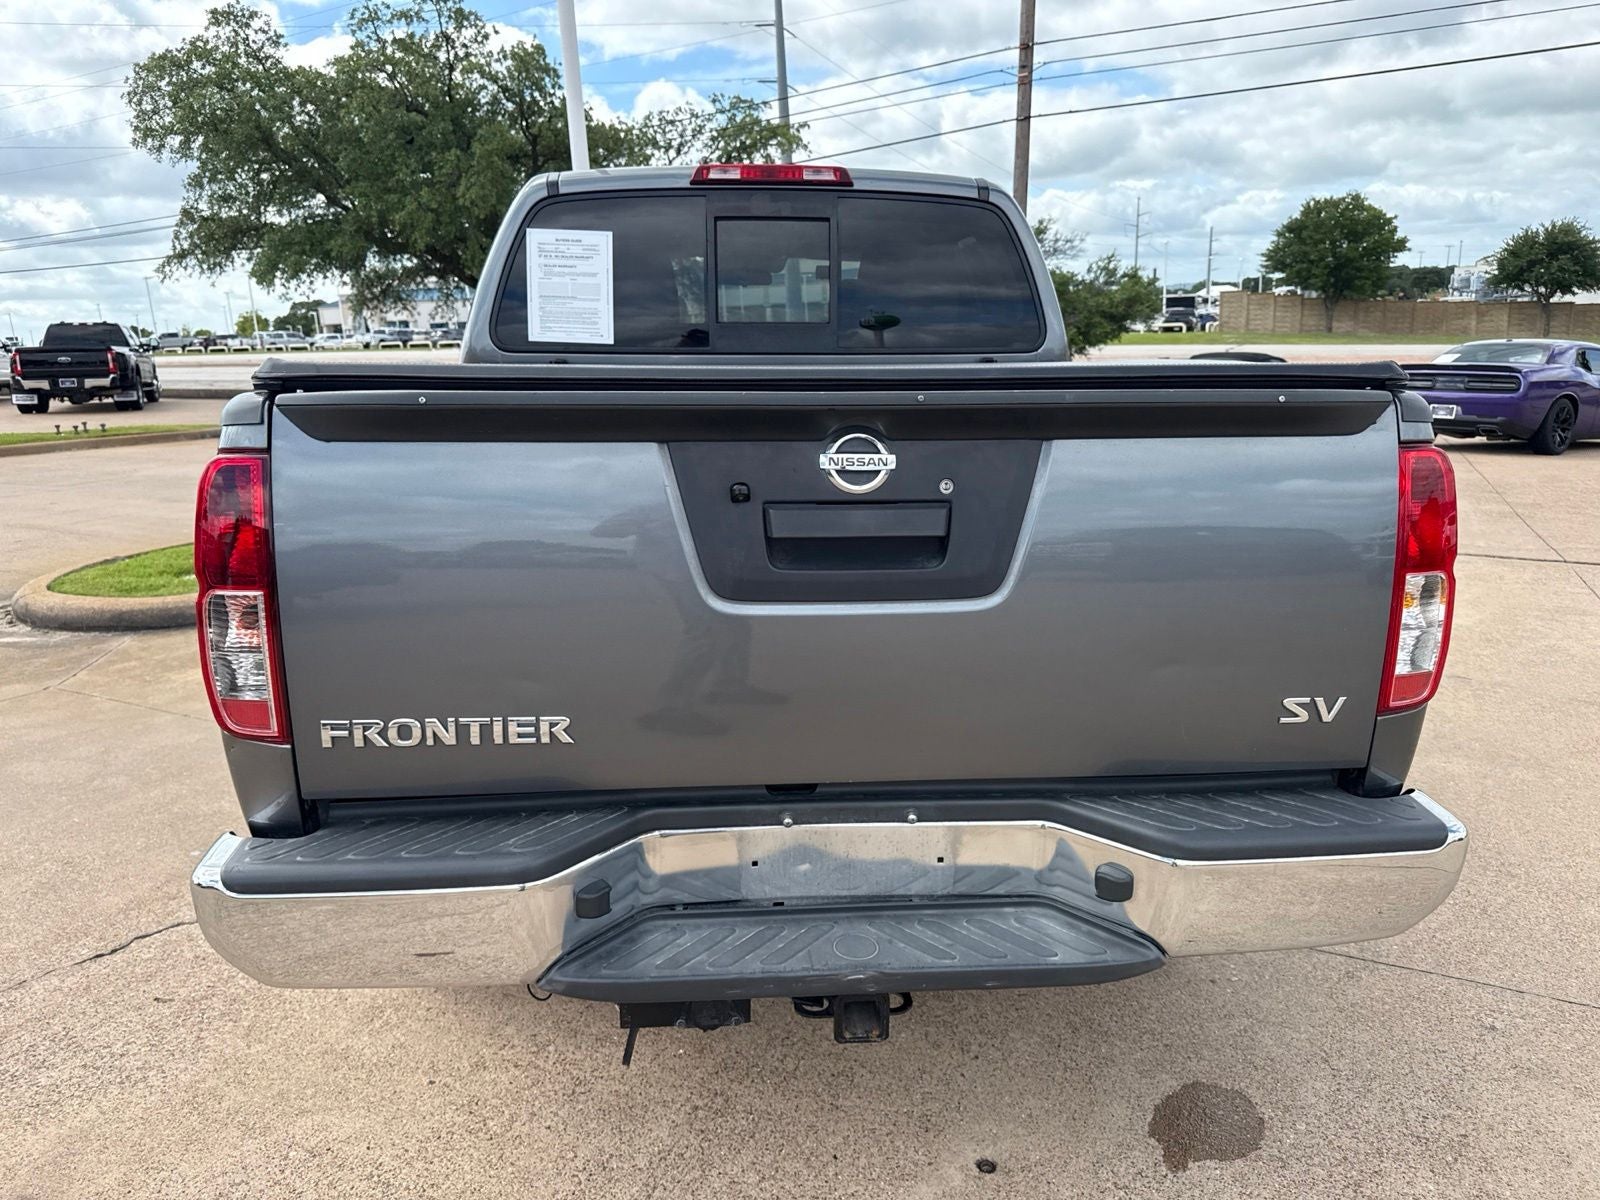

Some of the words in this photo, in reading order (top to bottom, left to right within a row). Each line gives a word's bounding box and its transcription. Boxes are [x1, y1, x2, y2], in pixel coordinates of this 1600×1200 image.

[828, 457, 888, 467] NISSAN
[1279, 696, 1347, 723] SV
[320, 716, 575, 748] FRONTIER
